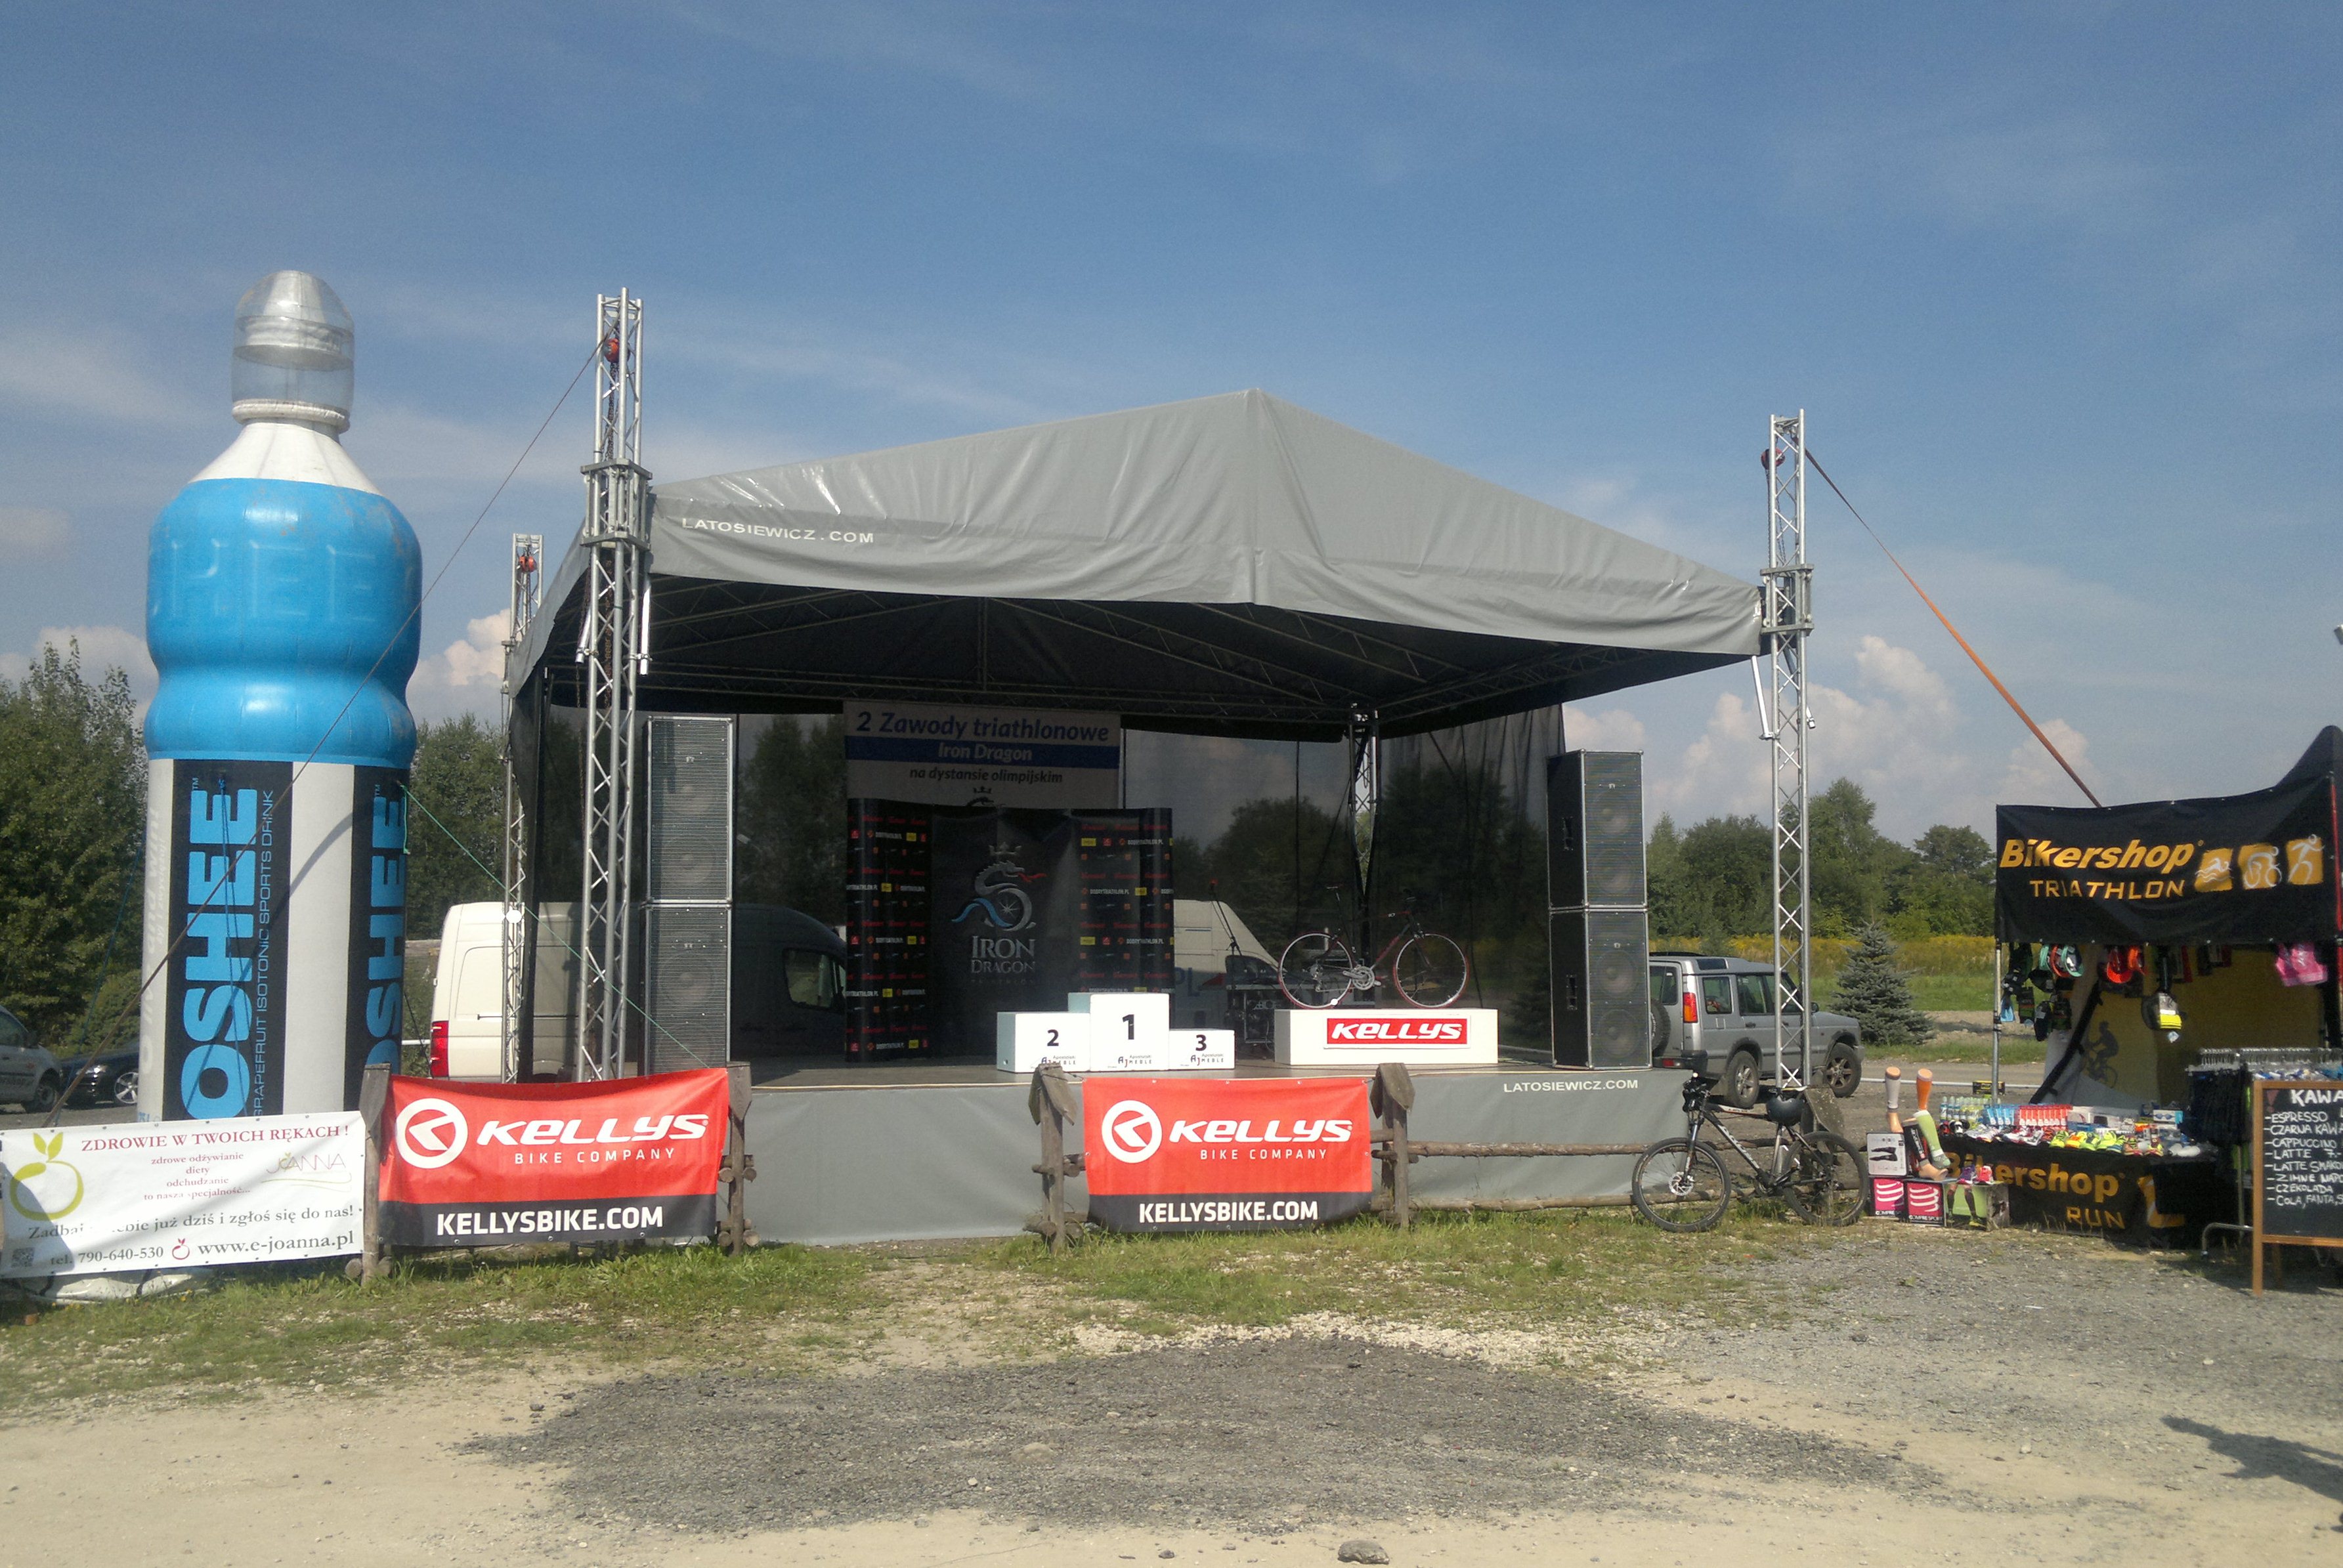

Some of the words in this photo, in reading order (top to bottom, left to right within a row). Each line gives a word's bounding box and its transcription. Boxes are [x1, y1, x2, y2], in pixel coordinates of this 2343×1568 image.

[857, 711, 872, 732] 2
[878, 711, 968, 740] Zawody
[973, 717, 1109, 742] triathlonowe
[938, 742, 971, 759] Iron
[974, 744, 1033, 763] Dragon
[909, 768, 926, 779] na
[928, 767, 989, 782] dystansie
[991, 770, 1063, 784] olimpijskim
[261, 790, 274, 846] DRINK
[1999, 838, 2195, 875] Bikershop
[259, 851, 272, 924] SPORTS
[2029, 879, 2185, 901] TRIATHLON
[181, 789, 258, 1120] OSHEE
[972, 935, 1037, 959] IRON
[255, 929, 270, 1011] ISOTONIC
[971, 959, 1036, 975] DRAGON
[1046, 1029, 1059, 1047] 2
[1122, 1014, 1134, 1040] 1
[1195, 1034, 1207, 1051] 3
[1503, 1080, 1639, 1092] LATOSIEWICZ.COM
[81, 1135, 167, 1151] ZDROWIE
[172, 1134, 187, 1146] W
[192, 1130, 264, 1145] TWOICH
[270, 1126, 341, 1143] RĘKACH
[151, 1156, 186, 1165] zdrowe
[515, 1152, 563, 1165] BIKE
[576, 1147, 676, 1164] COMPANY
[1200, 1149, 1239, 1160] BIKE
[1249, 1149, 1327, 1160] COMPANY
[186, 1166, 209, 1175] diety
[2310, 1161, 2343, 1173] SMAKO
[154, 1218, 178, 1232] już
[183, 1214, 214, 1227] dziś
[219, 1213, 225, 1224] i
[230, 1210, 270, 1227] zgłoś
[276, 1209, 296, 1223] się
[302, 1208, 320, 1219] do
[325, 1205, 353, 1218] nas!
[437, 1206, 663, 1236] KELLYSBIKE.COM
[1139, 1200, 1318, 1223] KELLYSBIKE.COM
[2066, 1206, 2126, 1229] RUN
[198, 1231, 354, 1254] www.e-joanna.pl
[78, 1247, 164, 1263] 790-640-530
